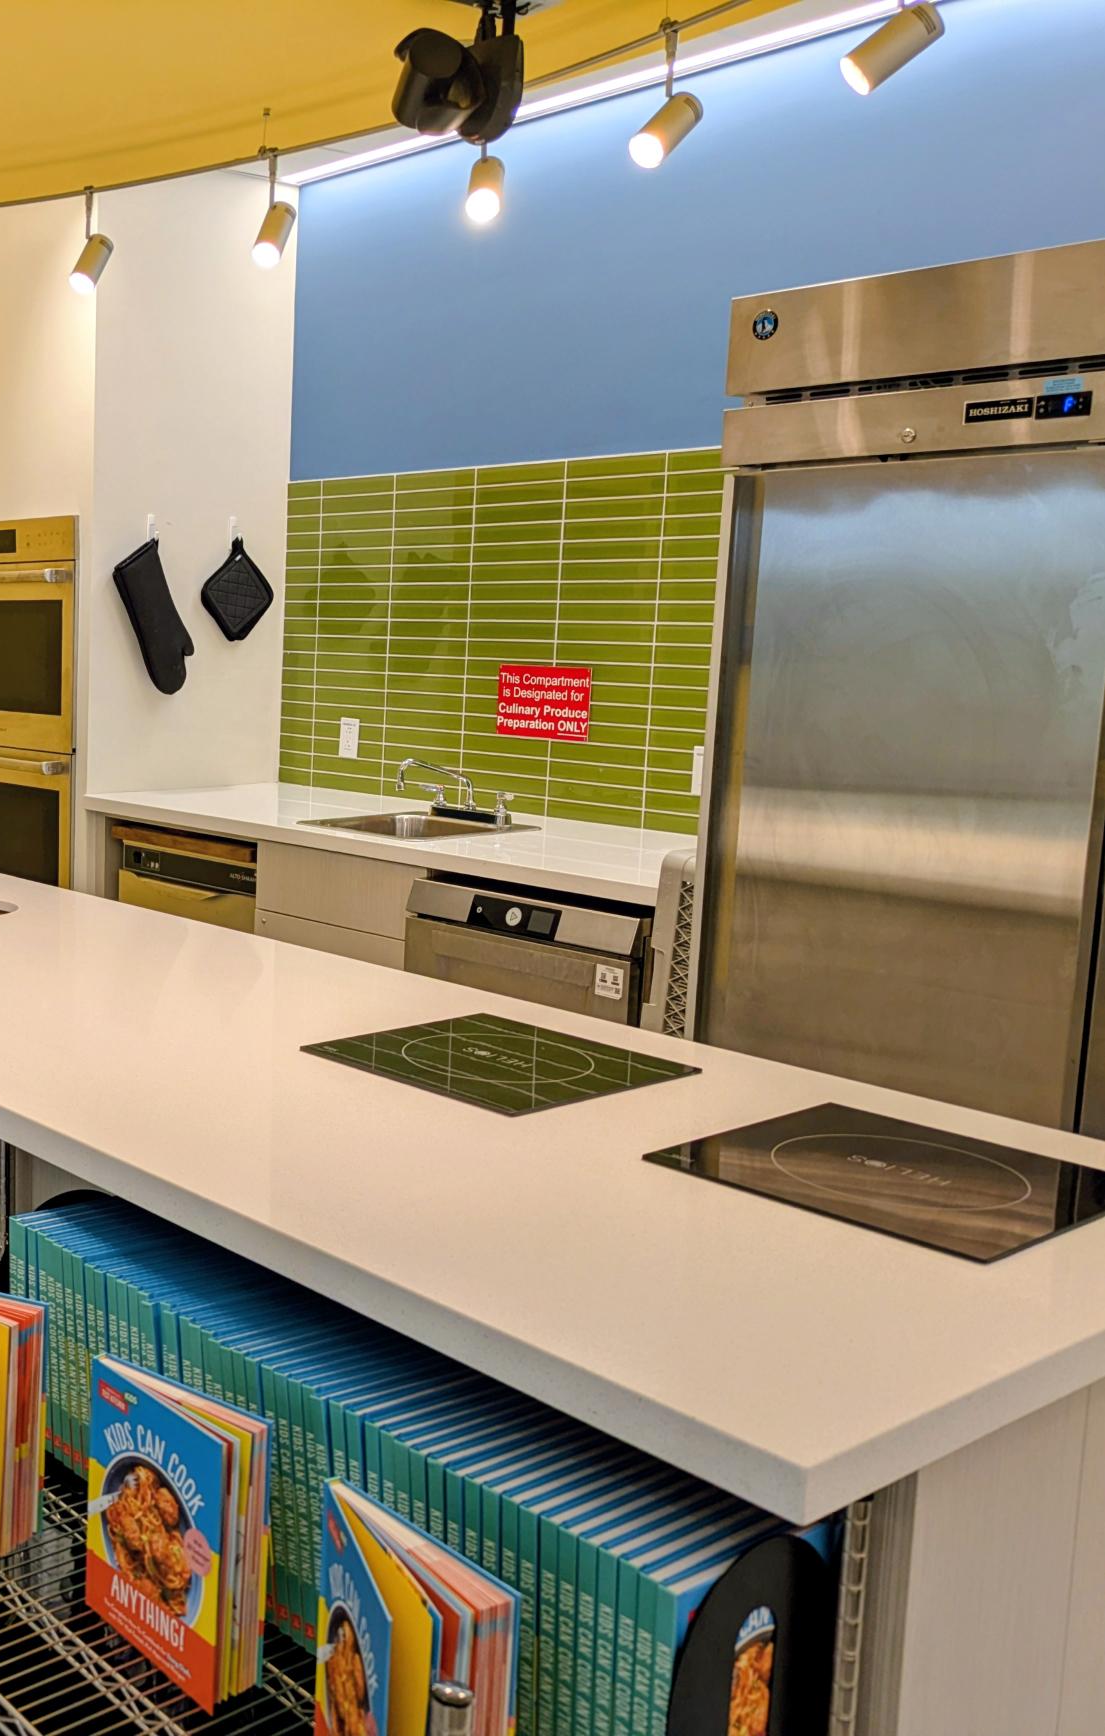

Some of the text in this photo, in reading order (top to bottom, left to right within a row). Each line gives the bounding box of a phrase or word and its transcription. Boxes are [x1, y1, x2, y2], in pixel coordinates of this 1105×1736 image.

[969, 403, 1029, 418] HOSHIZAKI
[500, 672, 590, 687] This Compartment
[502, 685, 584, 702] is Designated for
[496, 716, 588, 734] Preparation ONLY
[498, 702, 588, 720] Culinary Produce
[846, 1153, 953, 1188] HELIOS
[103, 1421, 205, 1516] KIDS CAN COOK
[482, 1538, 497, 1574] KIDS
[502, 1548, 516, 1581] KIDS
[520, 1559, 535, 1592] KIDS
[542, 1569, 556, 1603] KIDS
[111, 1573, 186, 1652] ANYTHING!
[520, 1594, 534, 1623] CAN
[560, 1580, 574, 1614] KIDS
[579, 1592, 594, 1627] KIDS
[540, 1604, 556, 1634] CAN
[559, 1616, 574, 1647] CAN
[598, 1603, 614, 1638] KIDS
[618, 1614, 635, 1650] KIDS
[578, 1628, 594, 1658] CAN
[597, 1640, 613, 1671] CAN
[637, 1628, 653, 1664] KIDS
[558, 1648, 574, 1682] COOK
[617, 1650, 634, 1682] CAN
[656, 1641, 672, 1679] KIDS
[576, 1660, 592, 1695] COOK
[596, 1672, 612, 1708] COOK
[636, 1665, 652, 1698] CAN
[616, 1683, 632, 1721] COOK
[654, 1680, 670, 1712] CAN
